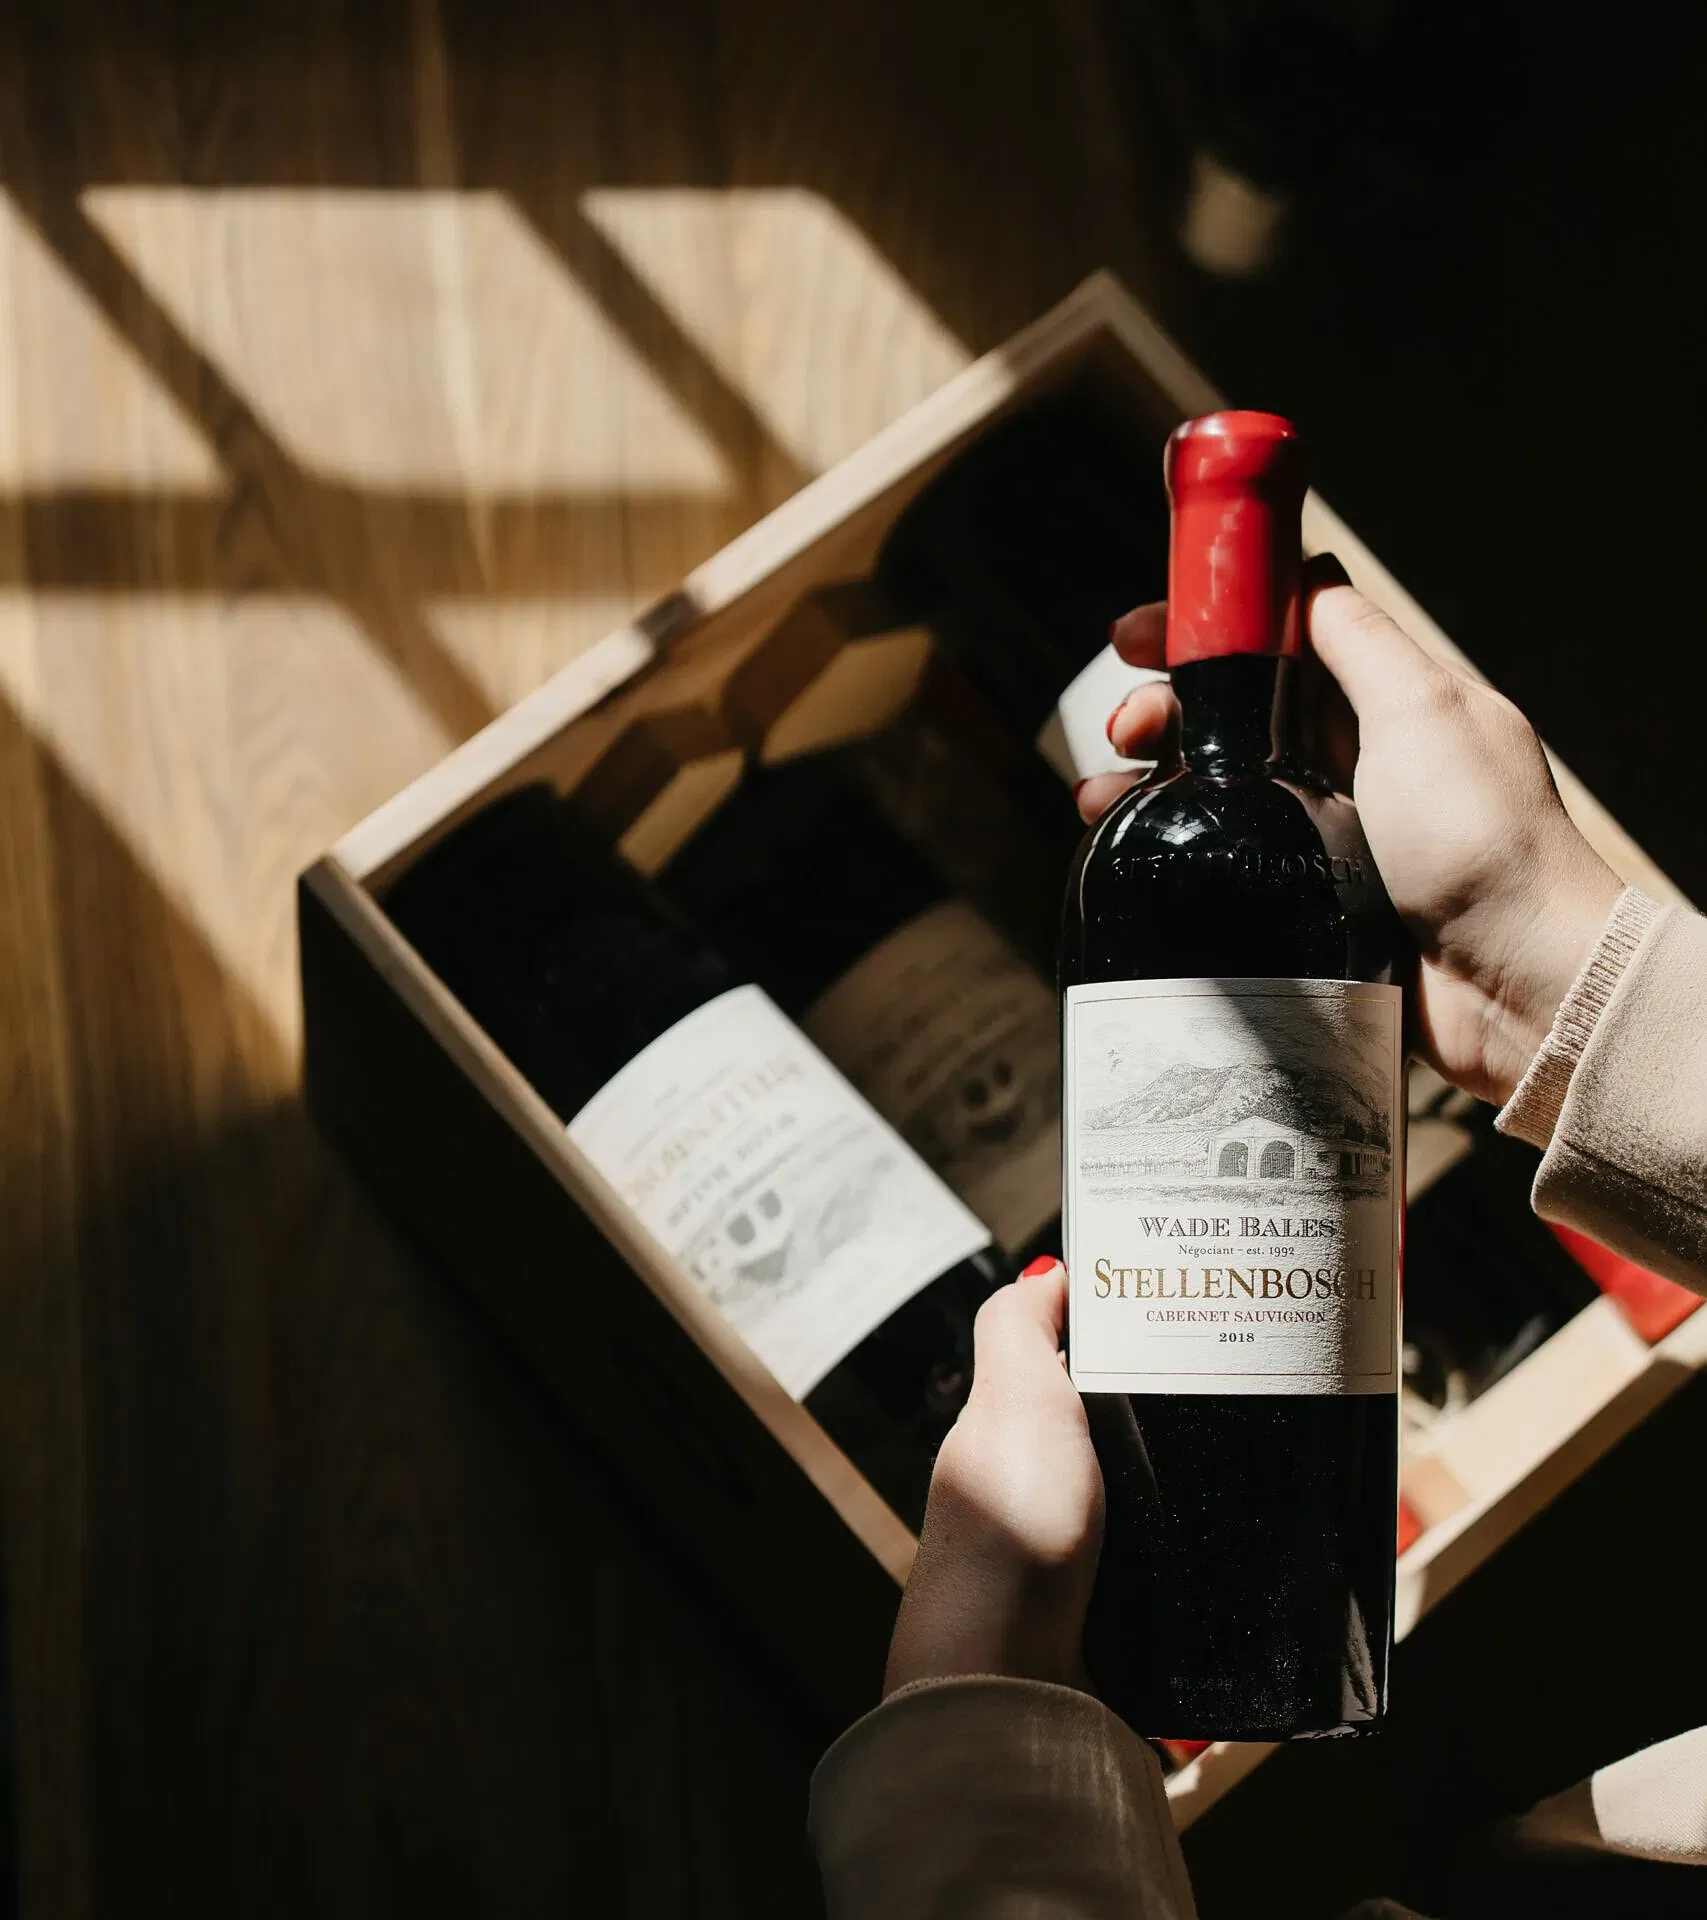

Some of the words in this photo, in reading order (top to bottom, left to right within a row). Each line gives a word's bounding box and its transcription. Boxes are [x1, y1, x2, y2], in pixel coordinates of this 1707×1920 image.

[1138, 1216, 1230, 1238] WADE
[1238, 1216, 1337, 1238] BALES
[1178, 1244, 1234, 1258] Négociant
[1246, 1246, 1265, 1256] est.
[1268, 1246, 1295, 1258] 1992
[1094, 1257, 1377, 1300] STELLENBOSCH
[1146, 1310, 1230, 1323] CABERNET
[1234, 1310, 1327, 1323] SAUVIGNON
[1218, 1332, 1255, 1343] 2018
